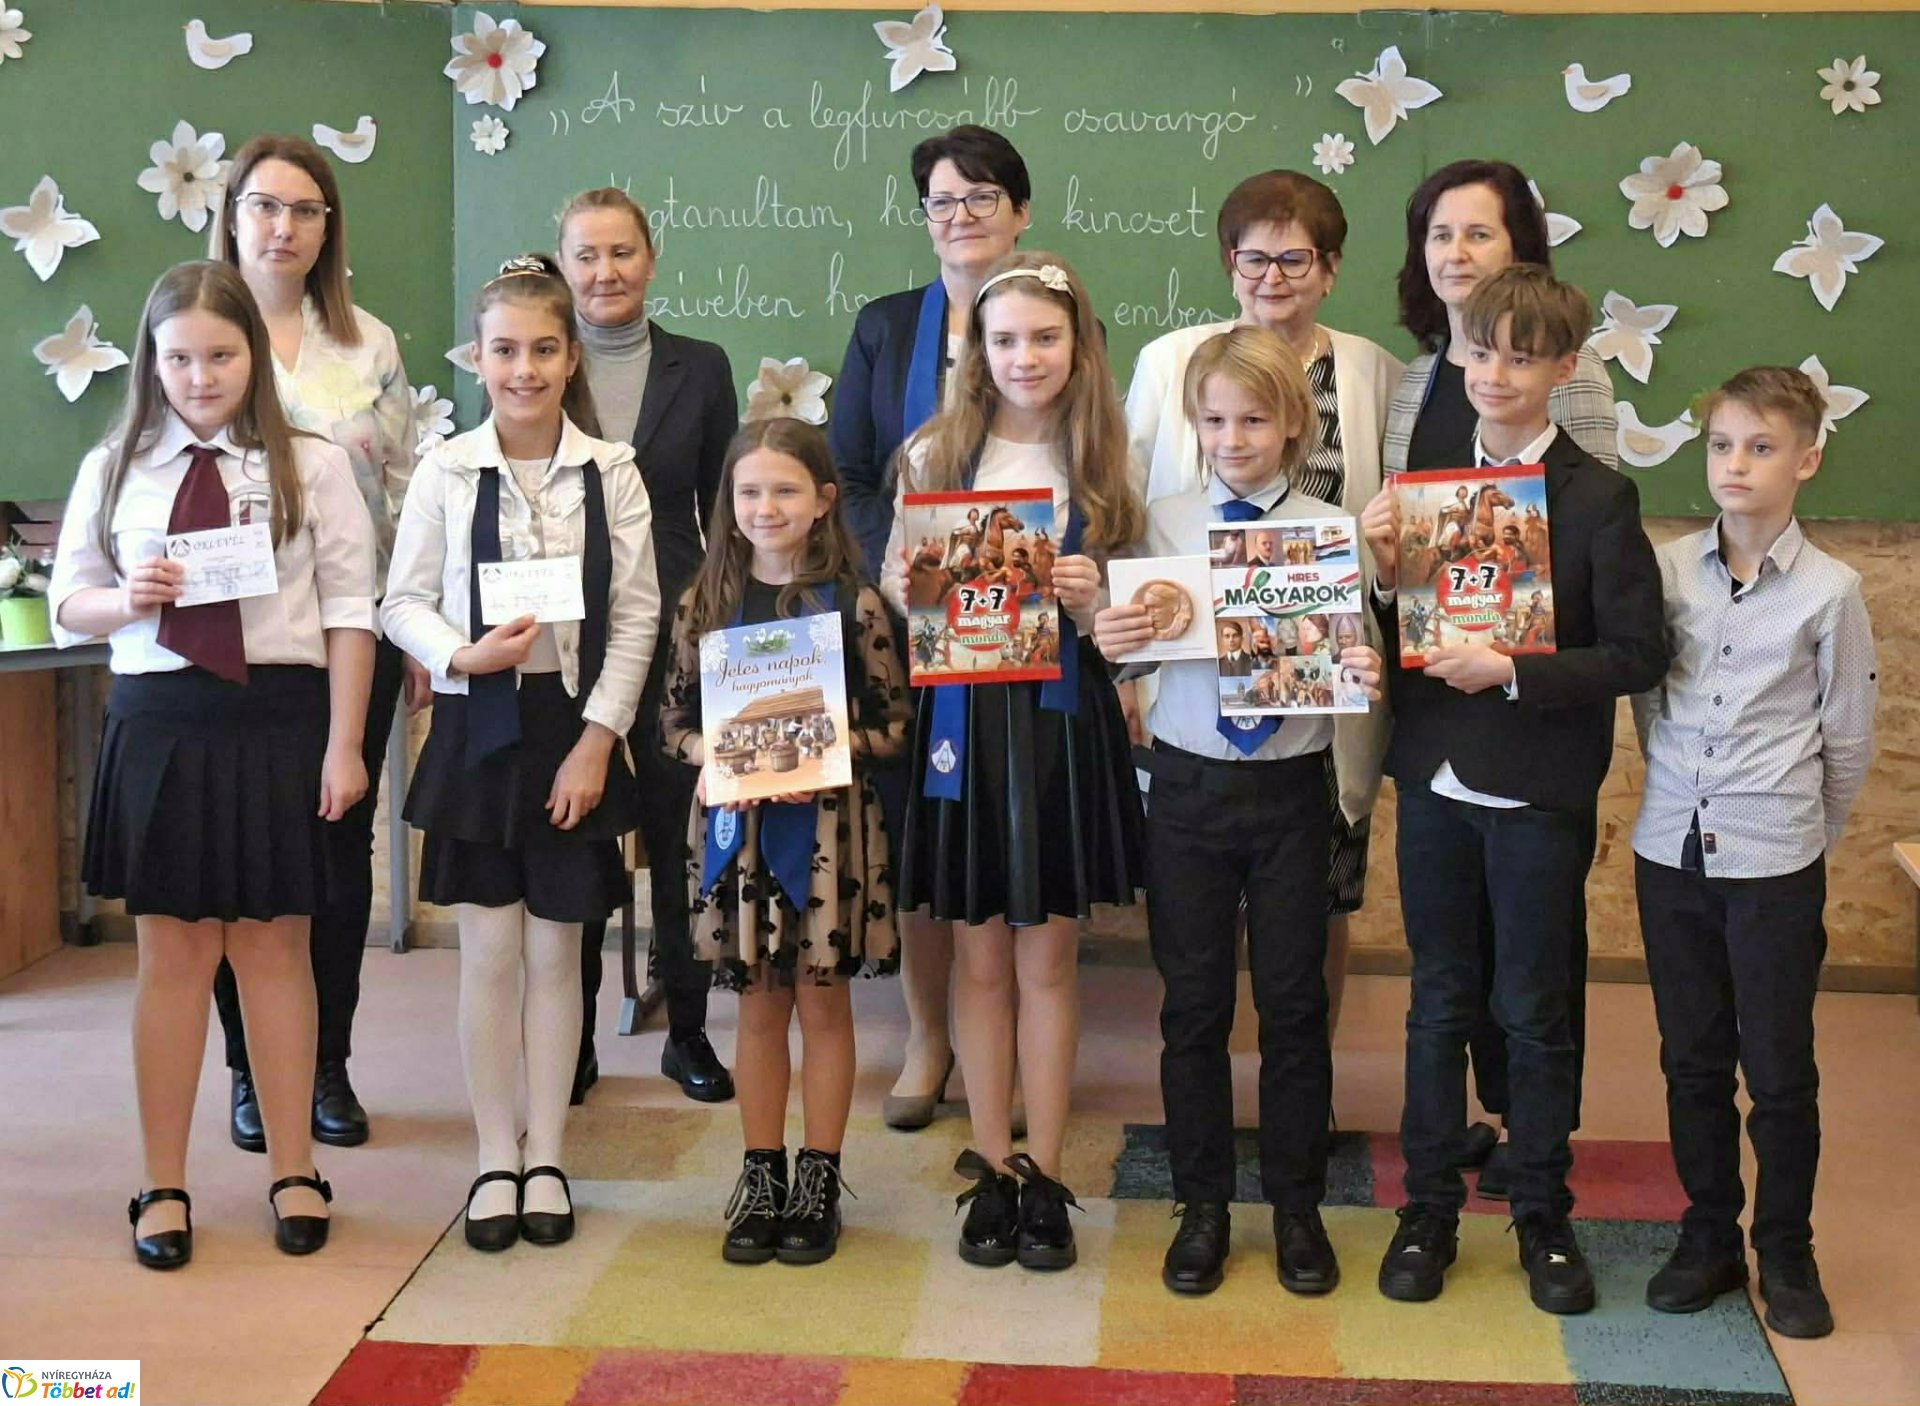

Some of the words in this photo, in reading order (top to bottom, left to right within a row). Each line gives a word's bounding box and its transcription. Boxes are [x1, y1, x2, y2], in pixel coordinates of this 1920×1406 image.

[656, 75, 743, 127] szív
[764, 107, 791, 128] a
[1061, 175, 1207, 237] kincset
[1224, 584, 1348, 606] MAGYAROK
[1448, 594, 1503, 607] magyar
[957, 615, 1010, 629] magyar
[716, 657, 759, 687] Jeles
[767, 645, 825, 675] napok
